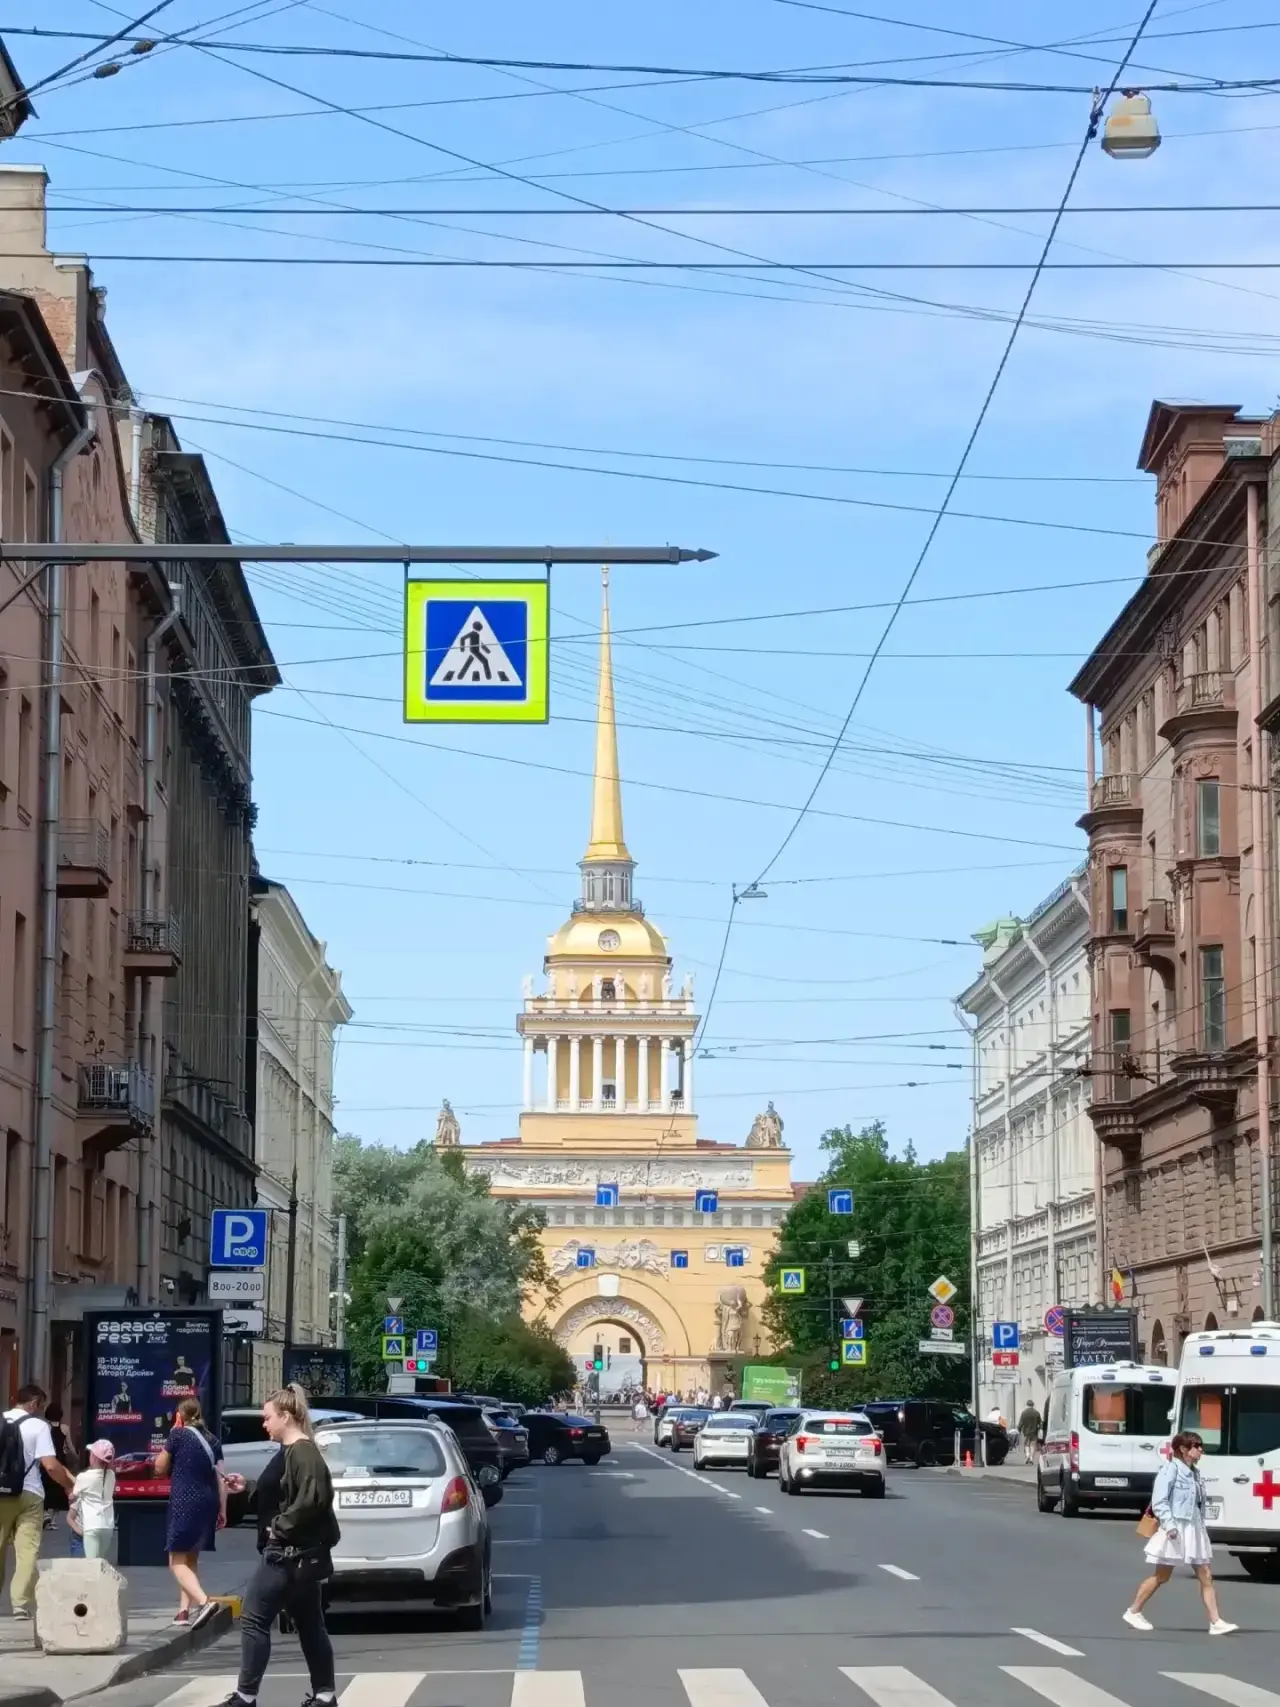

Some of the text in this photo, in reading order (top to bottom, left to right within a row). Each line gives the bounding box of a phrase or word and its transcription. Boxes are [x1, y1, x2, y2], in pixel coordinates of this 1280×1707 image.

[224, 1215, 254, 1258] P
[422, 1332, 434, 1348] P
[999, 1325, 1014, 1346] P
